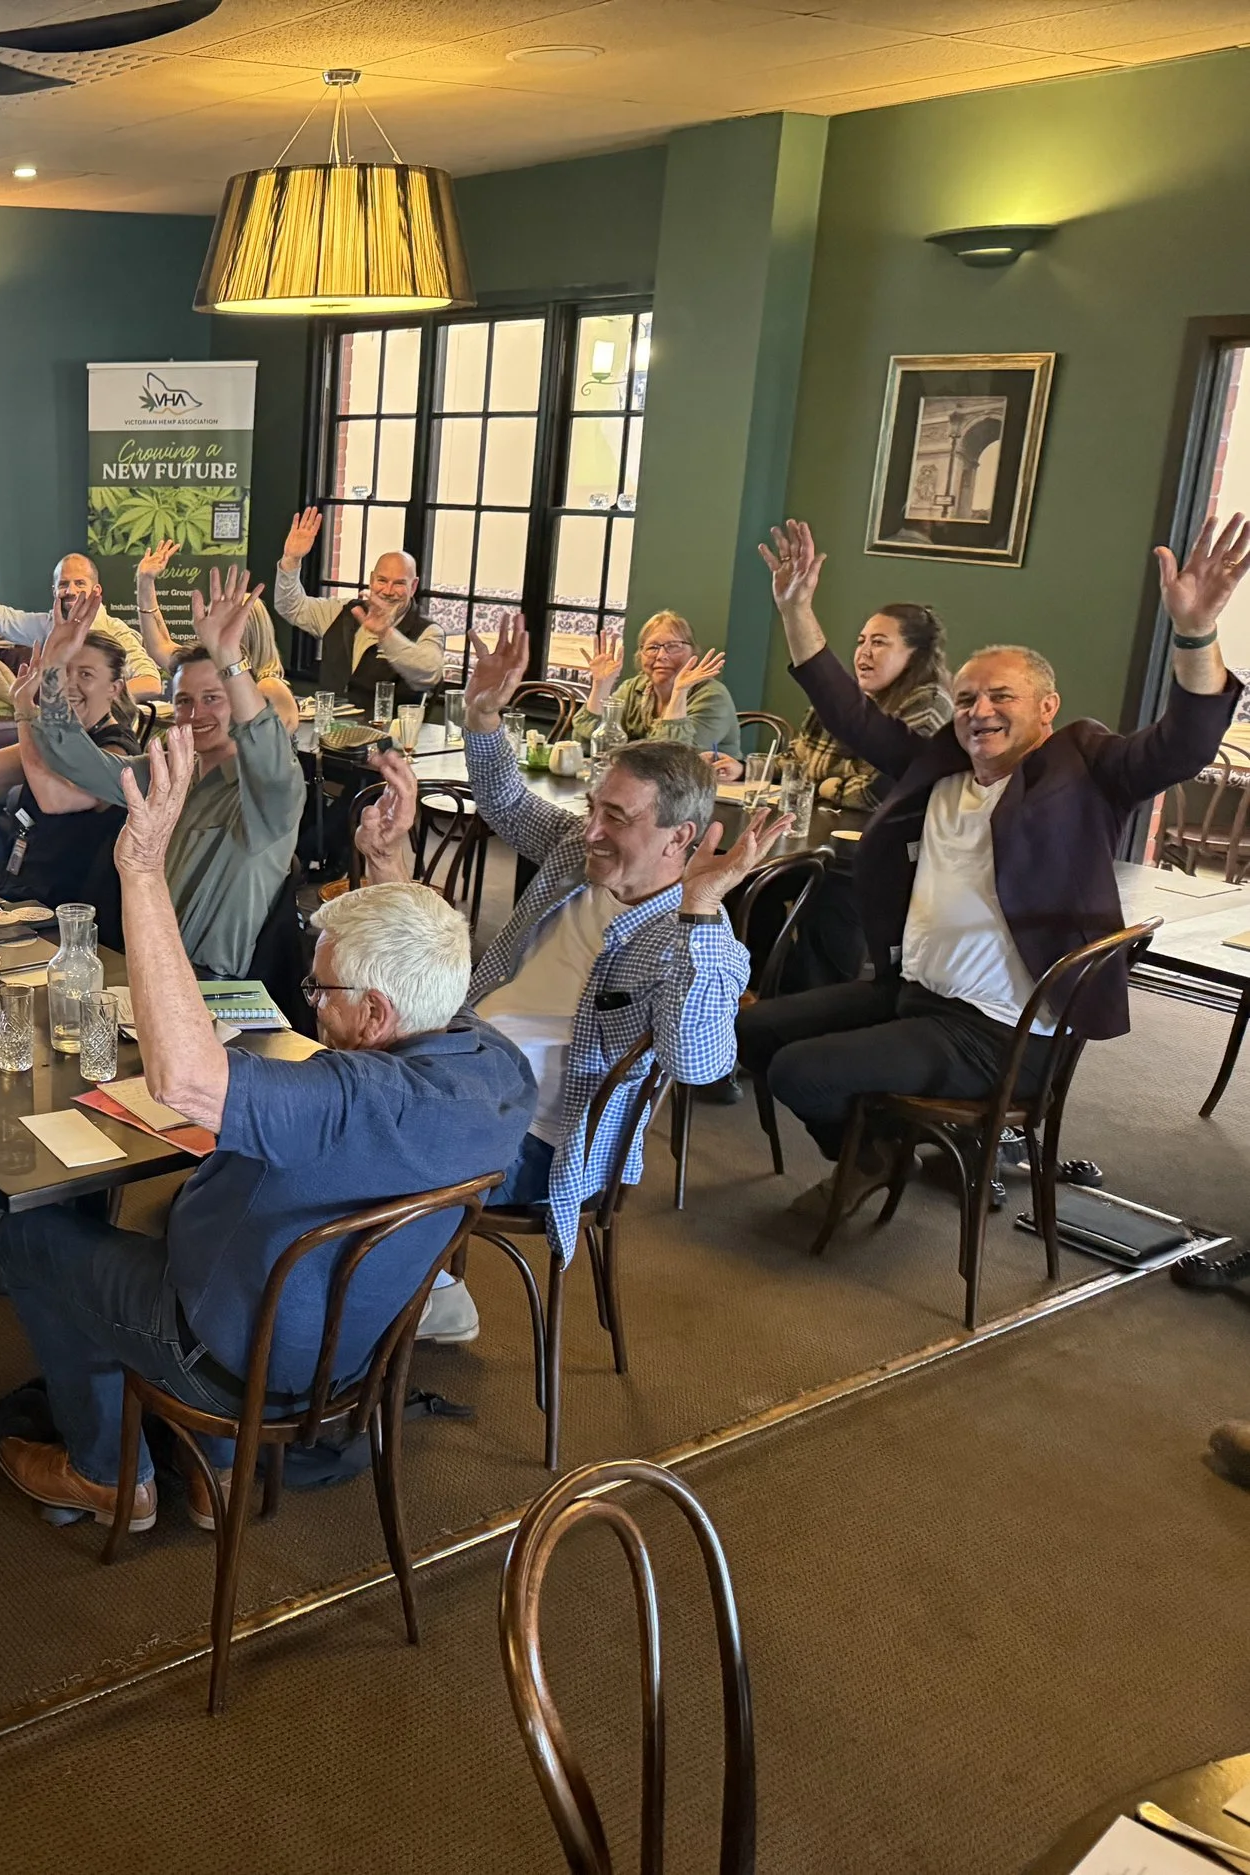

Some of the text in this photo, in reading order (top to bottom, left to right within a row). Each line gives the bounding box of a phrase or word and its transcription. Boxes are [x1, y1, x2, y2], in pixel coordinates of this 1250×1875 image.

[155, 393, 186, 407] VHA
[118, 439, 222, 470] Growing a
[103, 462, 237, 480] NEW FUTURE
